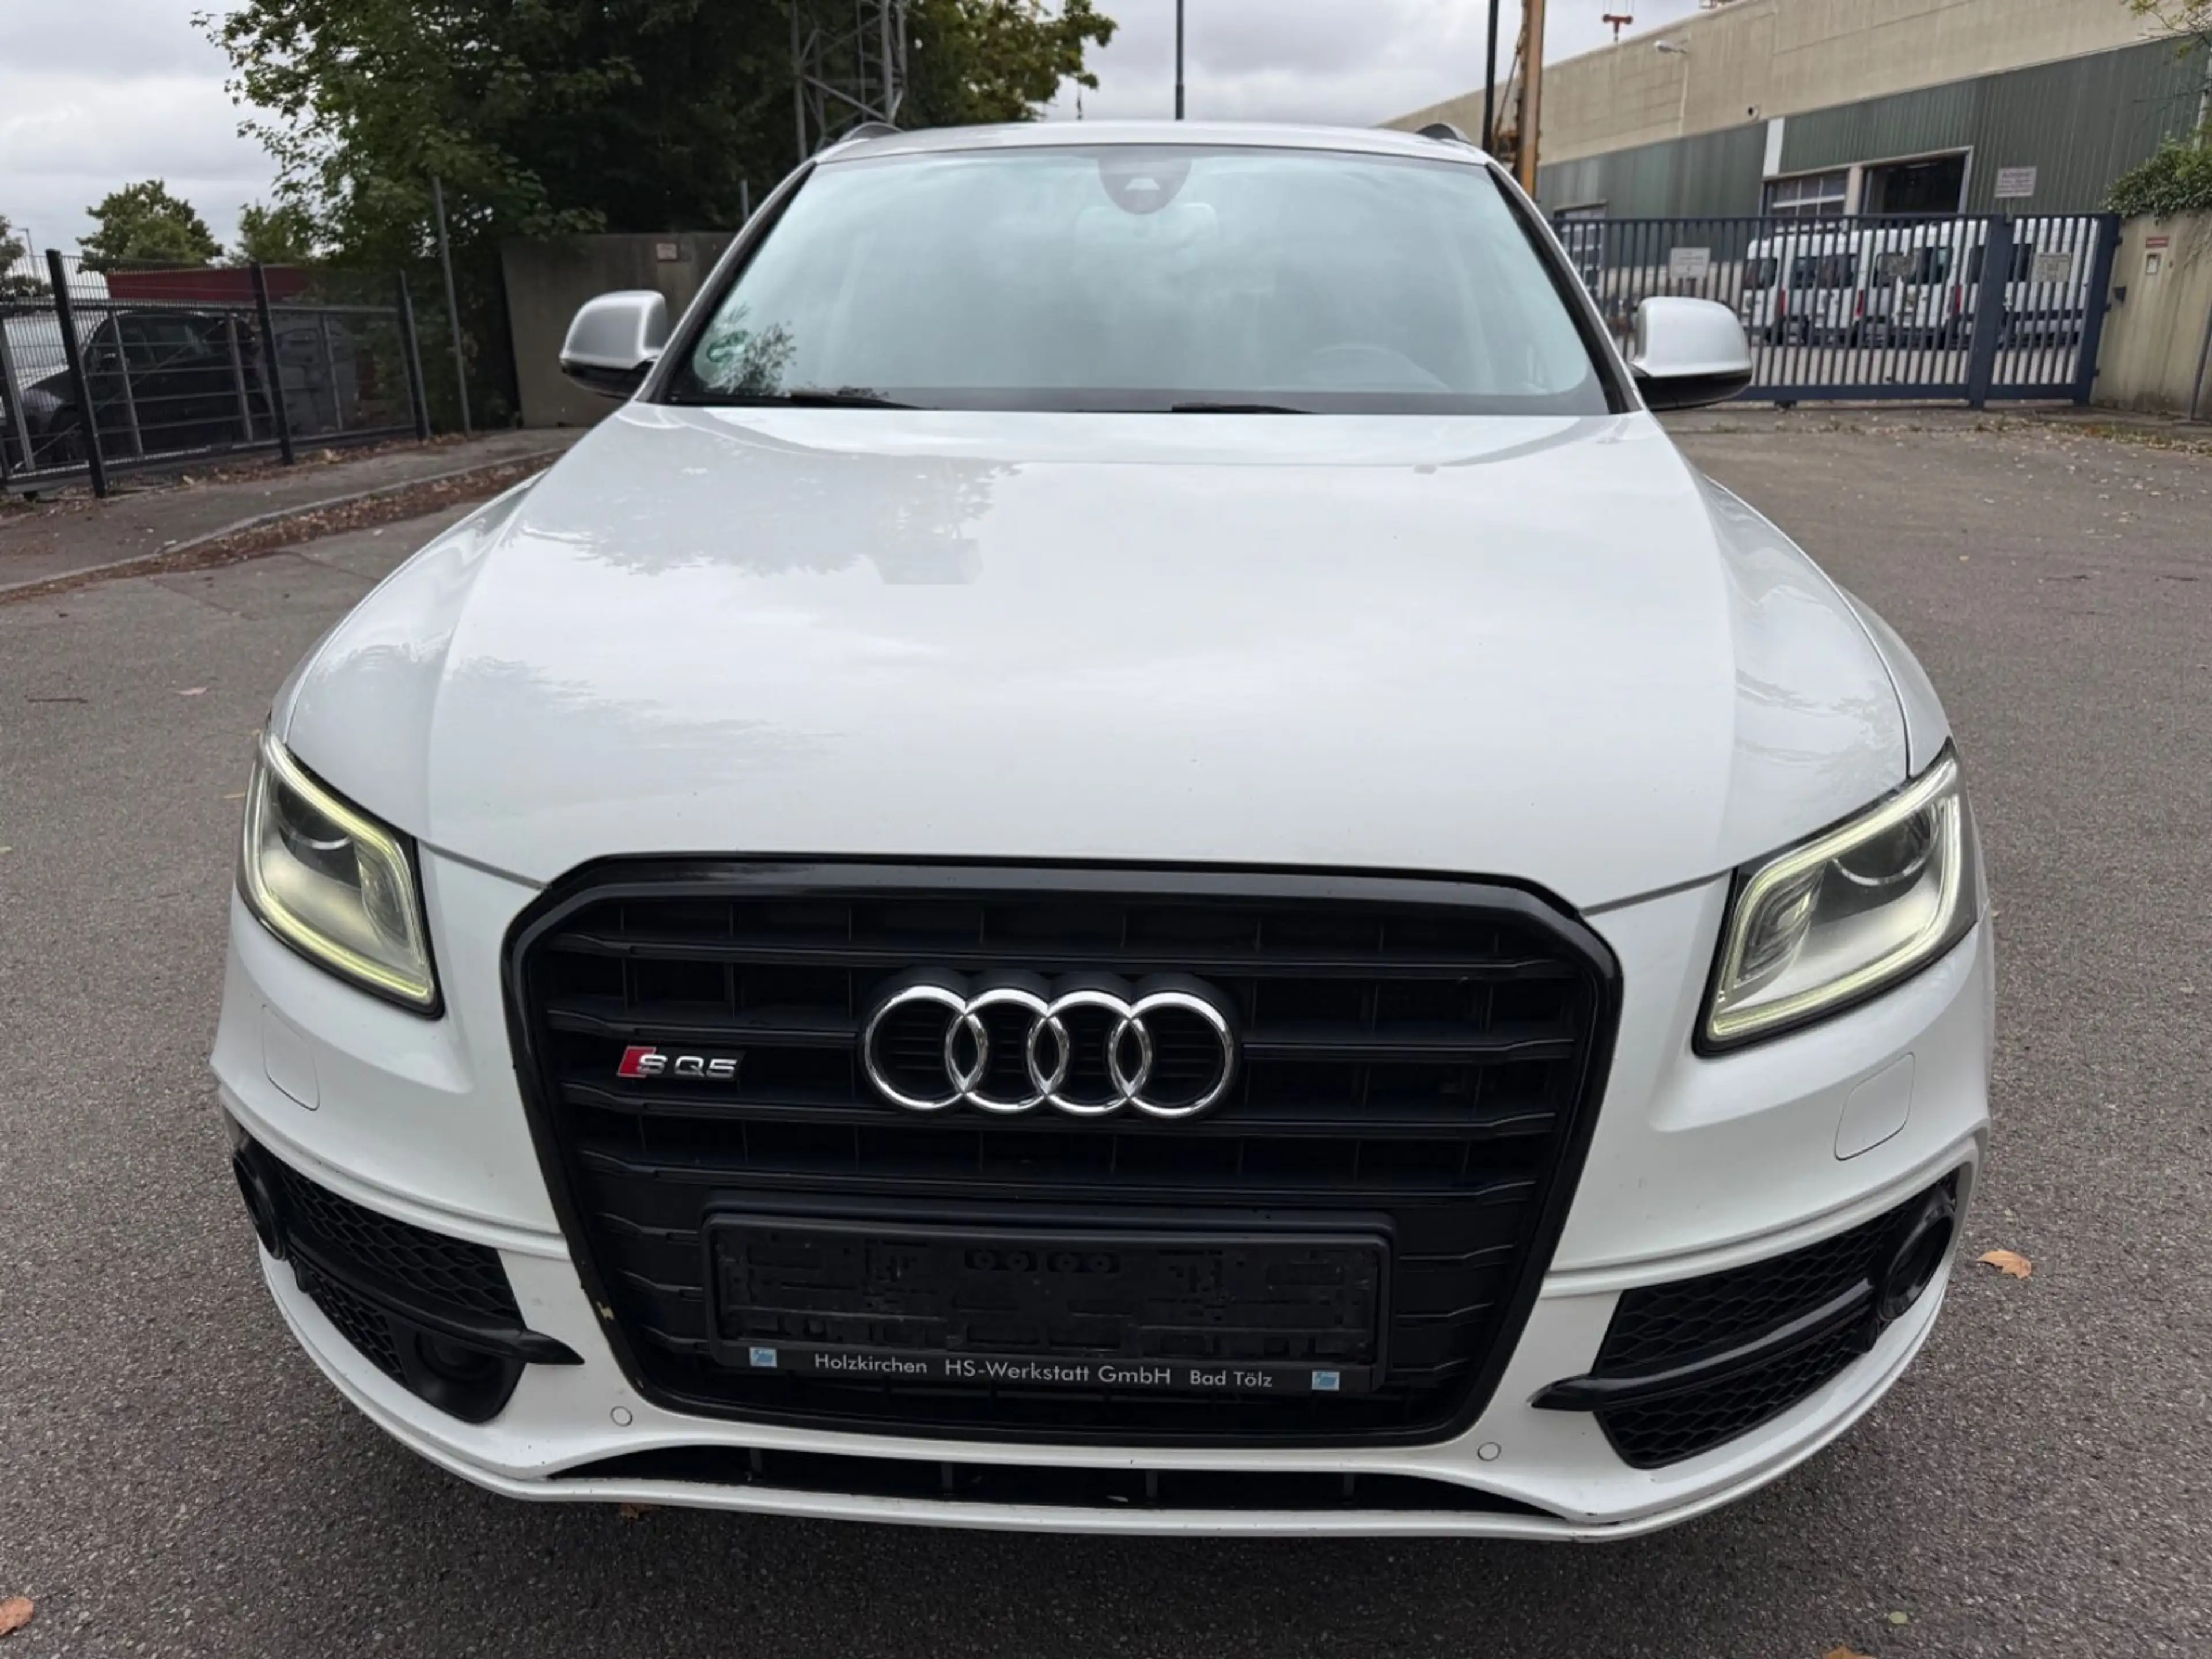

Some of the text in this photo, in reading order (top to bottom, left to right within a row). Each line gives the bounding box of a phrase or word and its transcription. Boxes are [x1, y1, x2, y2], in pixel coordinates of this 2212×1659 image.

[637, 1054, 738, 1079] SQ5
[814, 1353, 1273, 1387] Holzkirchen HS-Werkstatt GmbH Bad Tölz
